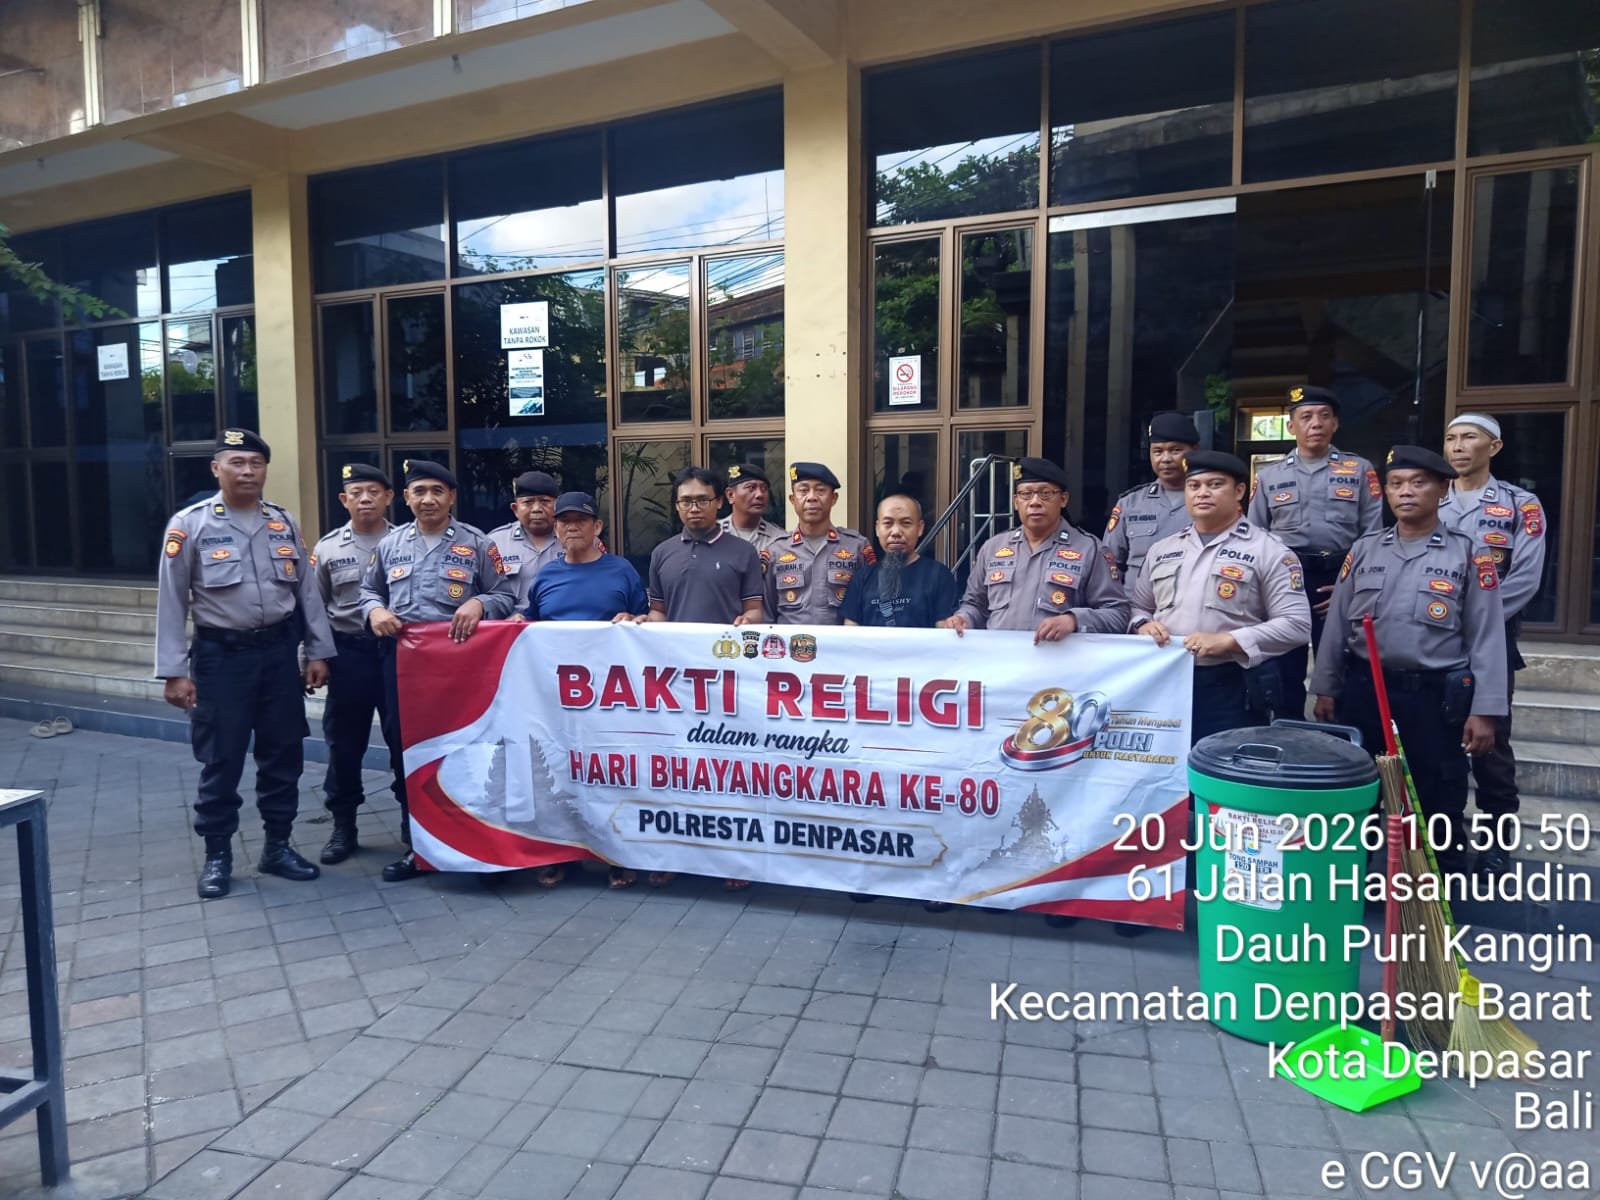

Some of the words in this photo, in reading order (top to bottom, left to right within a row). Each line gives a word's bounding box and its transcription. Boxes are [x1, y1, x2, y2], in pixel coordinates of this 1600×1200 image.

[509, 326, 540, 335] KAWASAN
[504, 337, 524, 345] TANPA
[525, 336, 546, 344] ROKOK
[1329, 477, 1359, 485] POLRI
[444, 555, 474, 567] POLRI
[1219, 549, 1255, 562] POLRI
[1049, 561, 1081, 573] POLRI
[1425, 566, 1463, 581] POLRI
[556, 664, 738, 716] BAKTI
[765, 671, 985, 729] RELIGI
[687, 721, 759, 747] dalam
[764, 729, 850, 760] rangka
[1093, 731, 1155, 752] POLRI
[1082, 750, 1113, 761] UNTUK
[569, 749, 639, 789] HARI
[650, 754, 887, 808] BHAYANGKARA
[899, 772, 1000, 819] KE-80
[639, 809, 765, 843] POLRESTA
[774, 820, 914, 858] DENPASAR
[1229, 853, 1246, 863] TONG
[1247, 857, 1278, 868] SAMPAH
